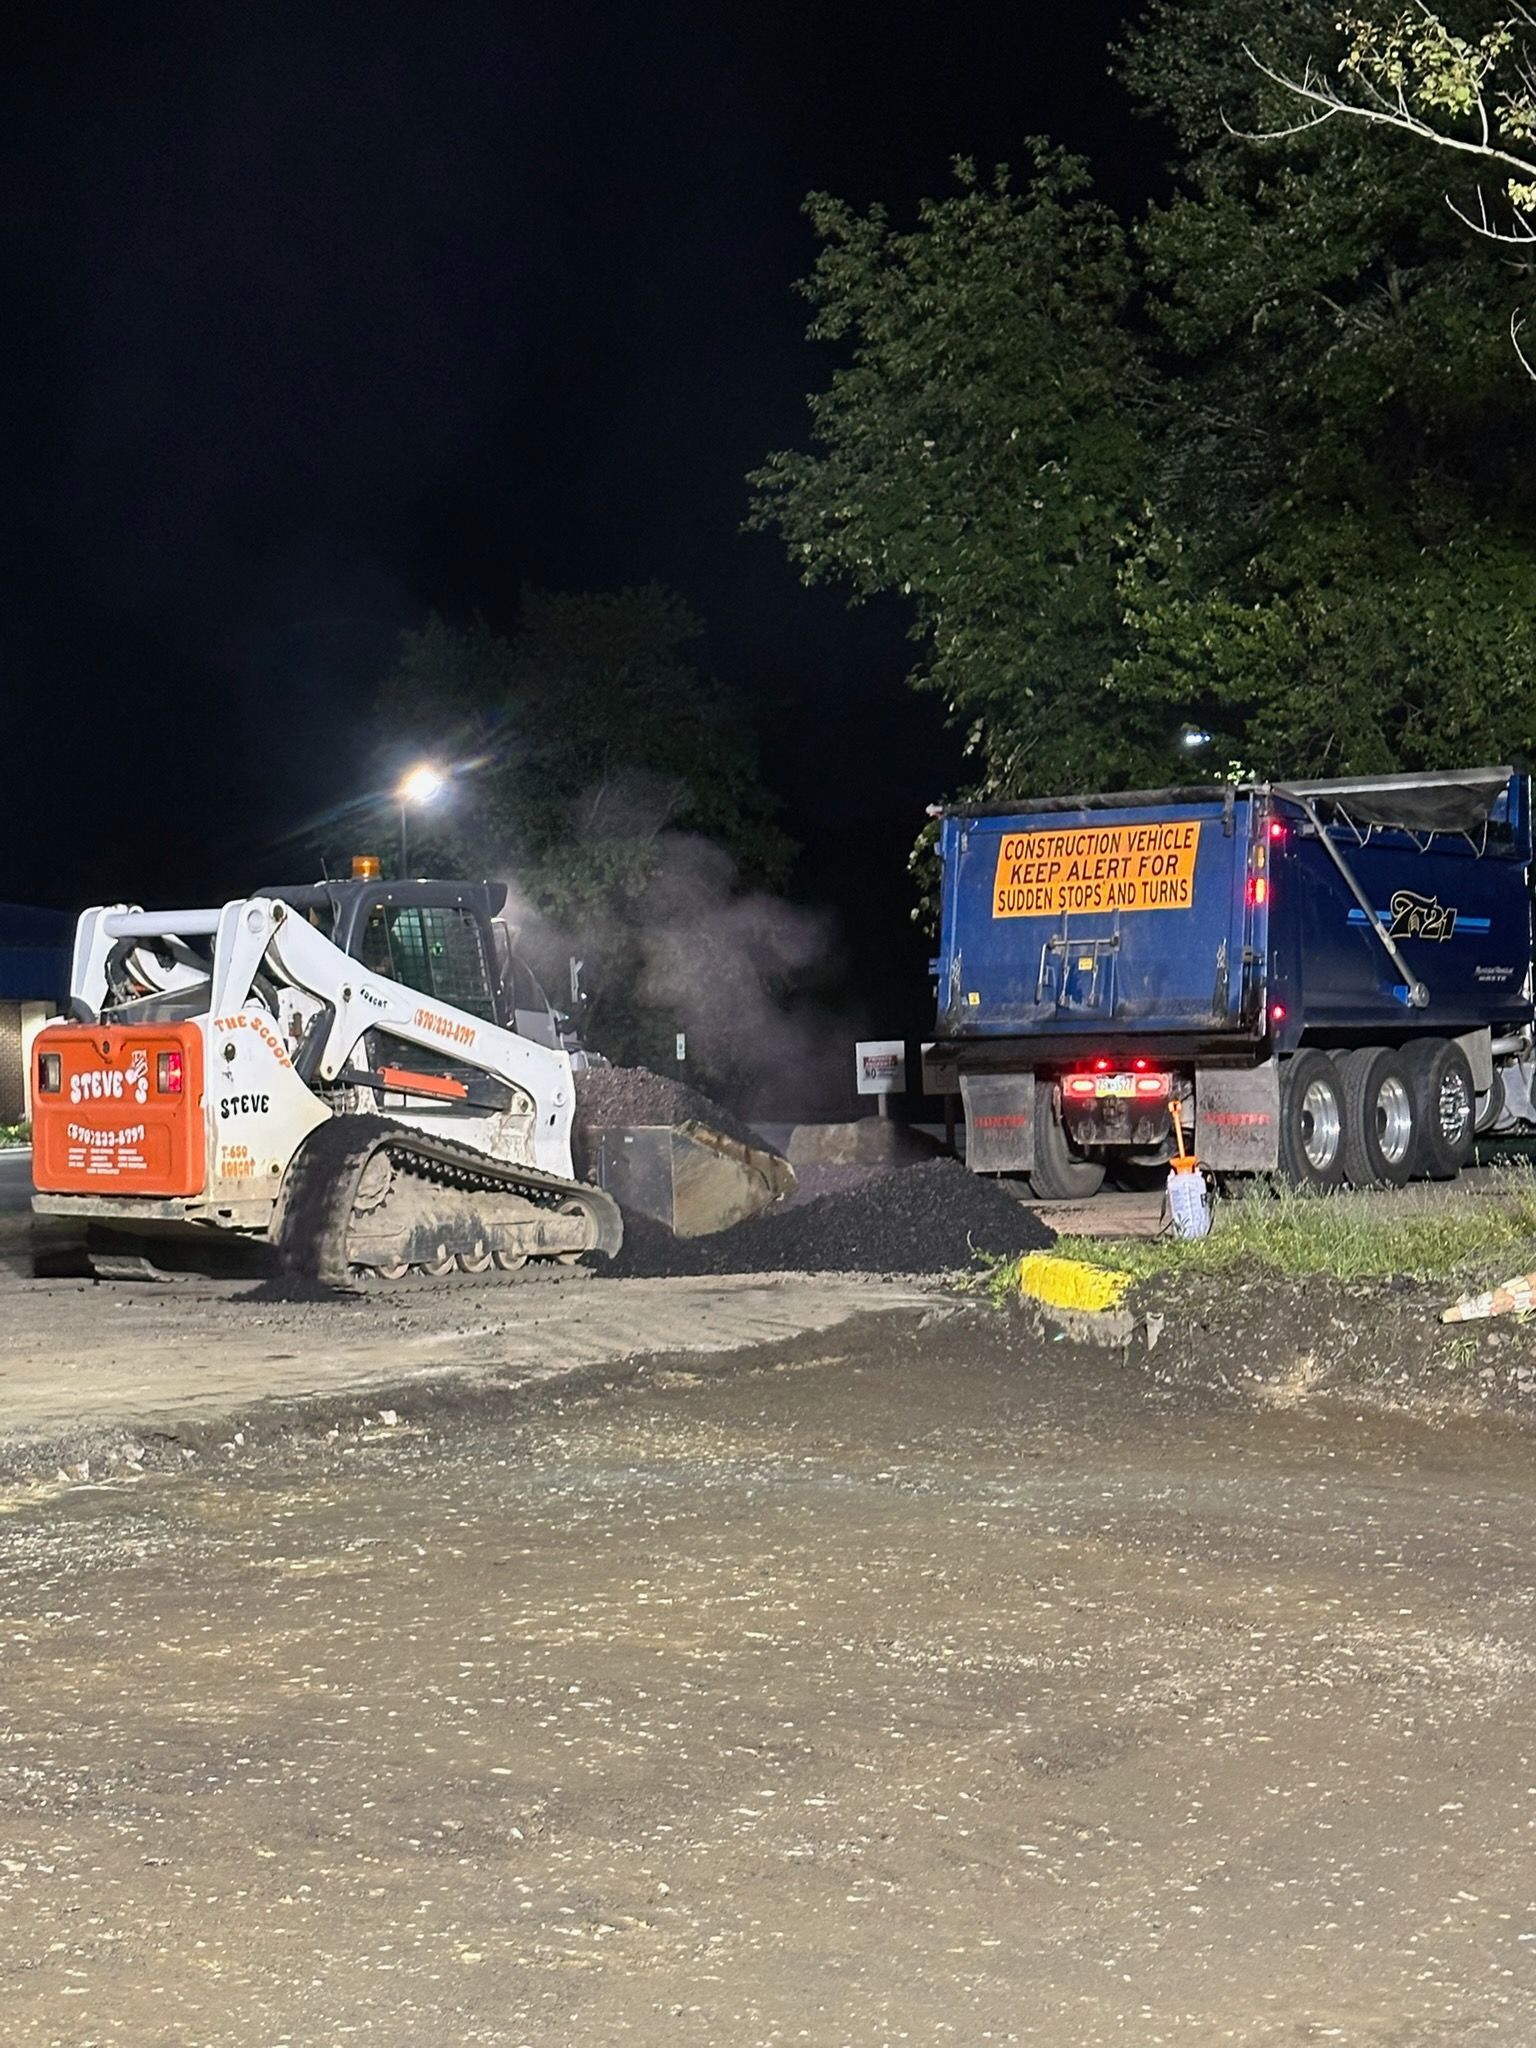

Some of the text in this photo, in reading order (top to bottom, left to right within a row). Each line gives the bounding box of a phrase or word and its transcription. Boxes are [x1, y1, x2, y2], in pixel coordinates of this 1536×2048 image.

[1005, 828, 1194, 860] CONSTRUCTION VEHICLE
[1010, 854, 1178, 885] KEEP ALERT FOR
[998, 879, 1187, 912] SUDDEN STOPS AND TURNS
[214, 1015, 291, 1069] THE SCOOP
[221, 1094, 269, 1119] STEVE
[221, 1145, 248, 1158] T-650
